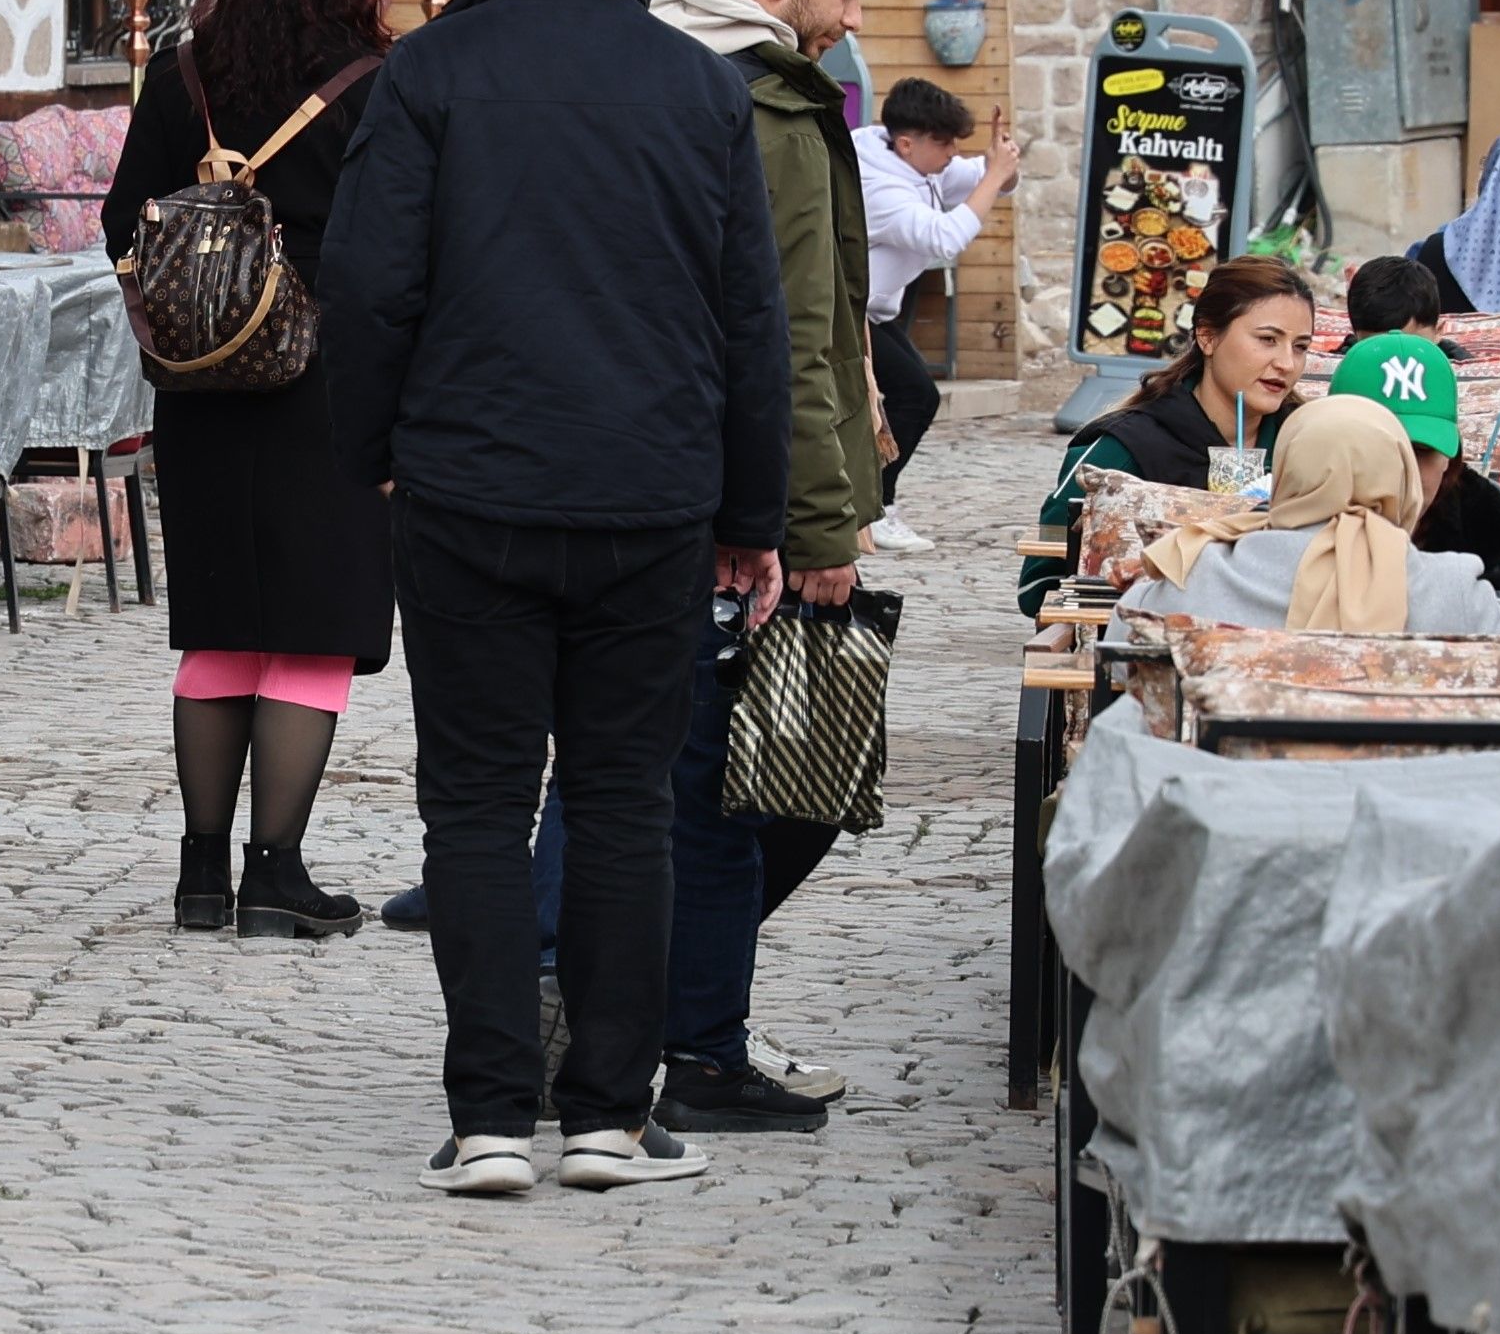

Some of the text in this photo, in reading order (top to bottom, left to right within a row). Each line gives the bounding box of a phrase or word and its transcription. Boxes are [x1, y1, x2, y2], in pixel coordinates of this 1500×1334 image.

[1107, 104, 1187, 135] Serpme
[1118, 130, 1224, 162] Kahvaltı
[1380, 355, 1427, 401] NY
